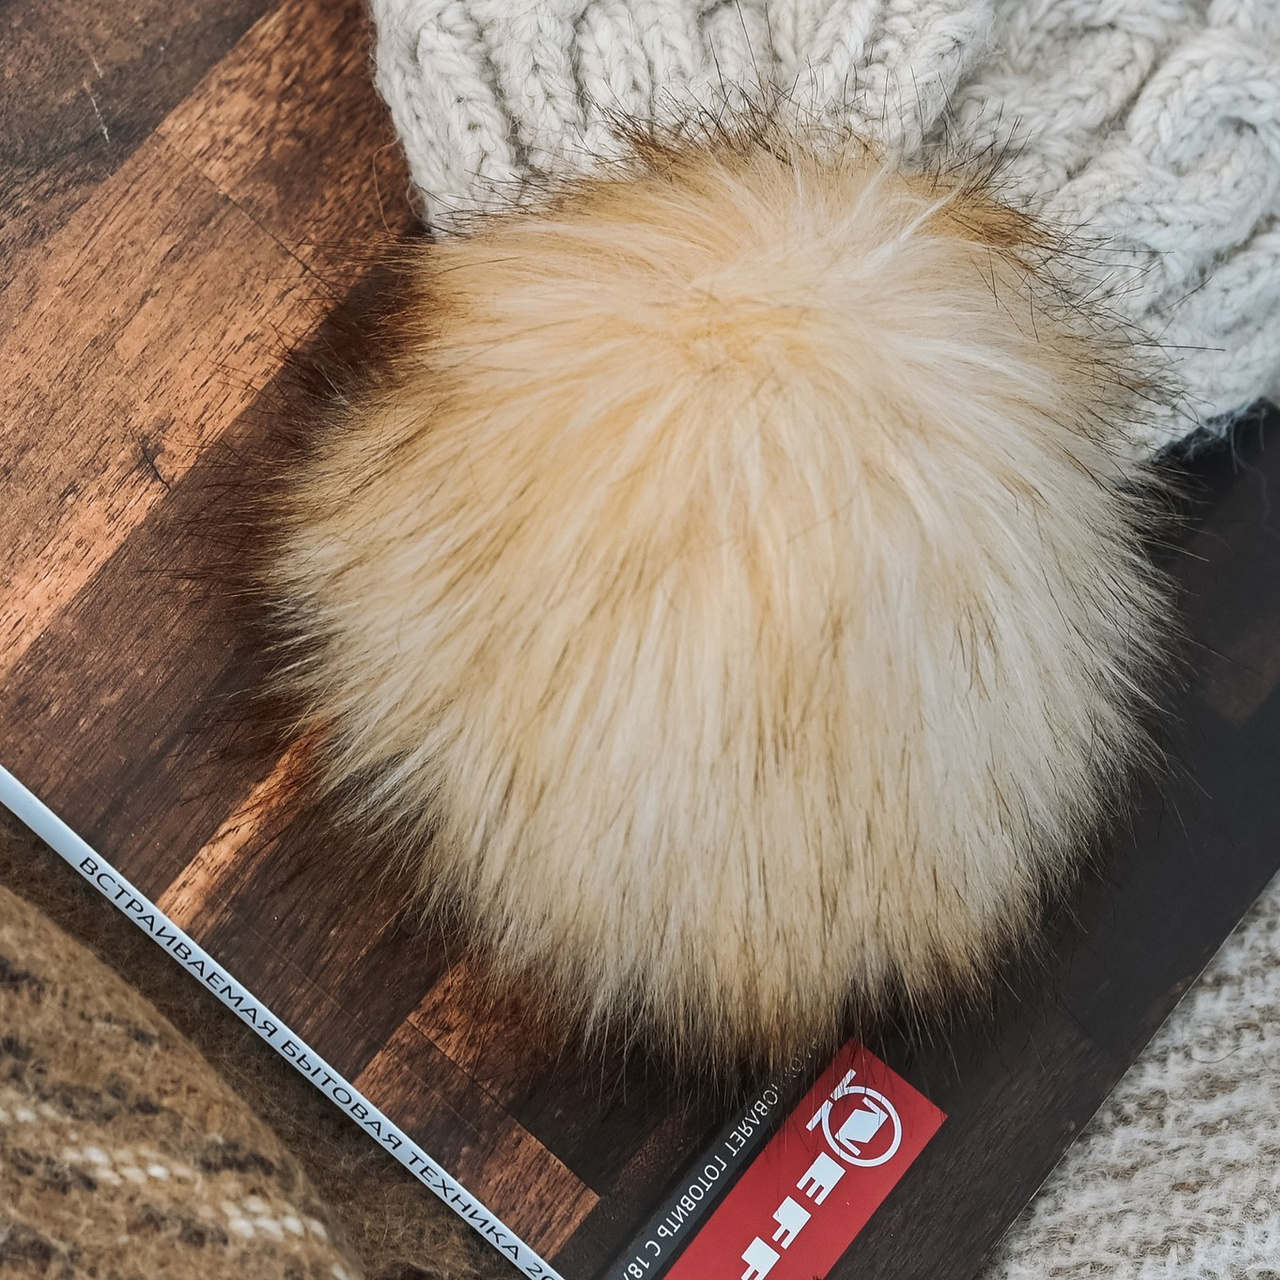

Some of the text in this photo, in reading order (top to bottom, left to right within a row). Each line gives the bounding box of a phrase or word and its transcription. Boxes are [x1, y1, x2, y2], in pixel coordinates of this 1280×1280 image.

[78, 856, 278, 1038] ВСТРАИВАЕМАЯ
[279, 1039, 404, 1151] БЫТОВАЯ
[407, 1150, 519, 1261] ТЕХНИКА
[644, 1239, 661, 1257] С
[656, 1154, 727, 1237] ГОТОВИТЬ
[740, 1093, 889, 1280] NEFF
